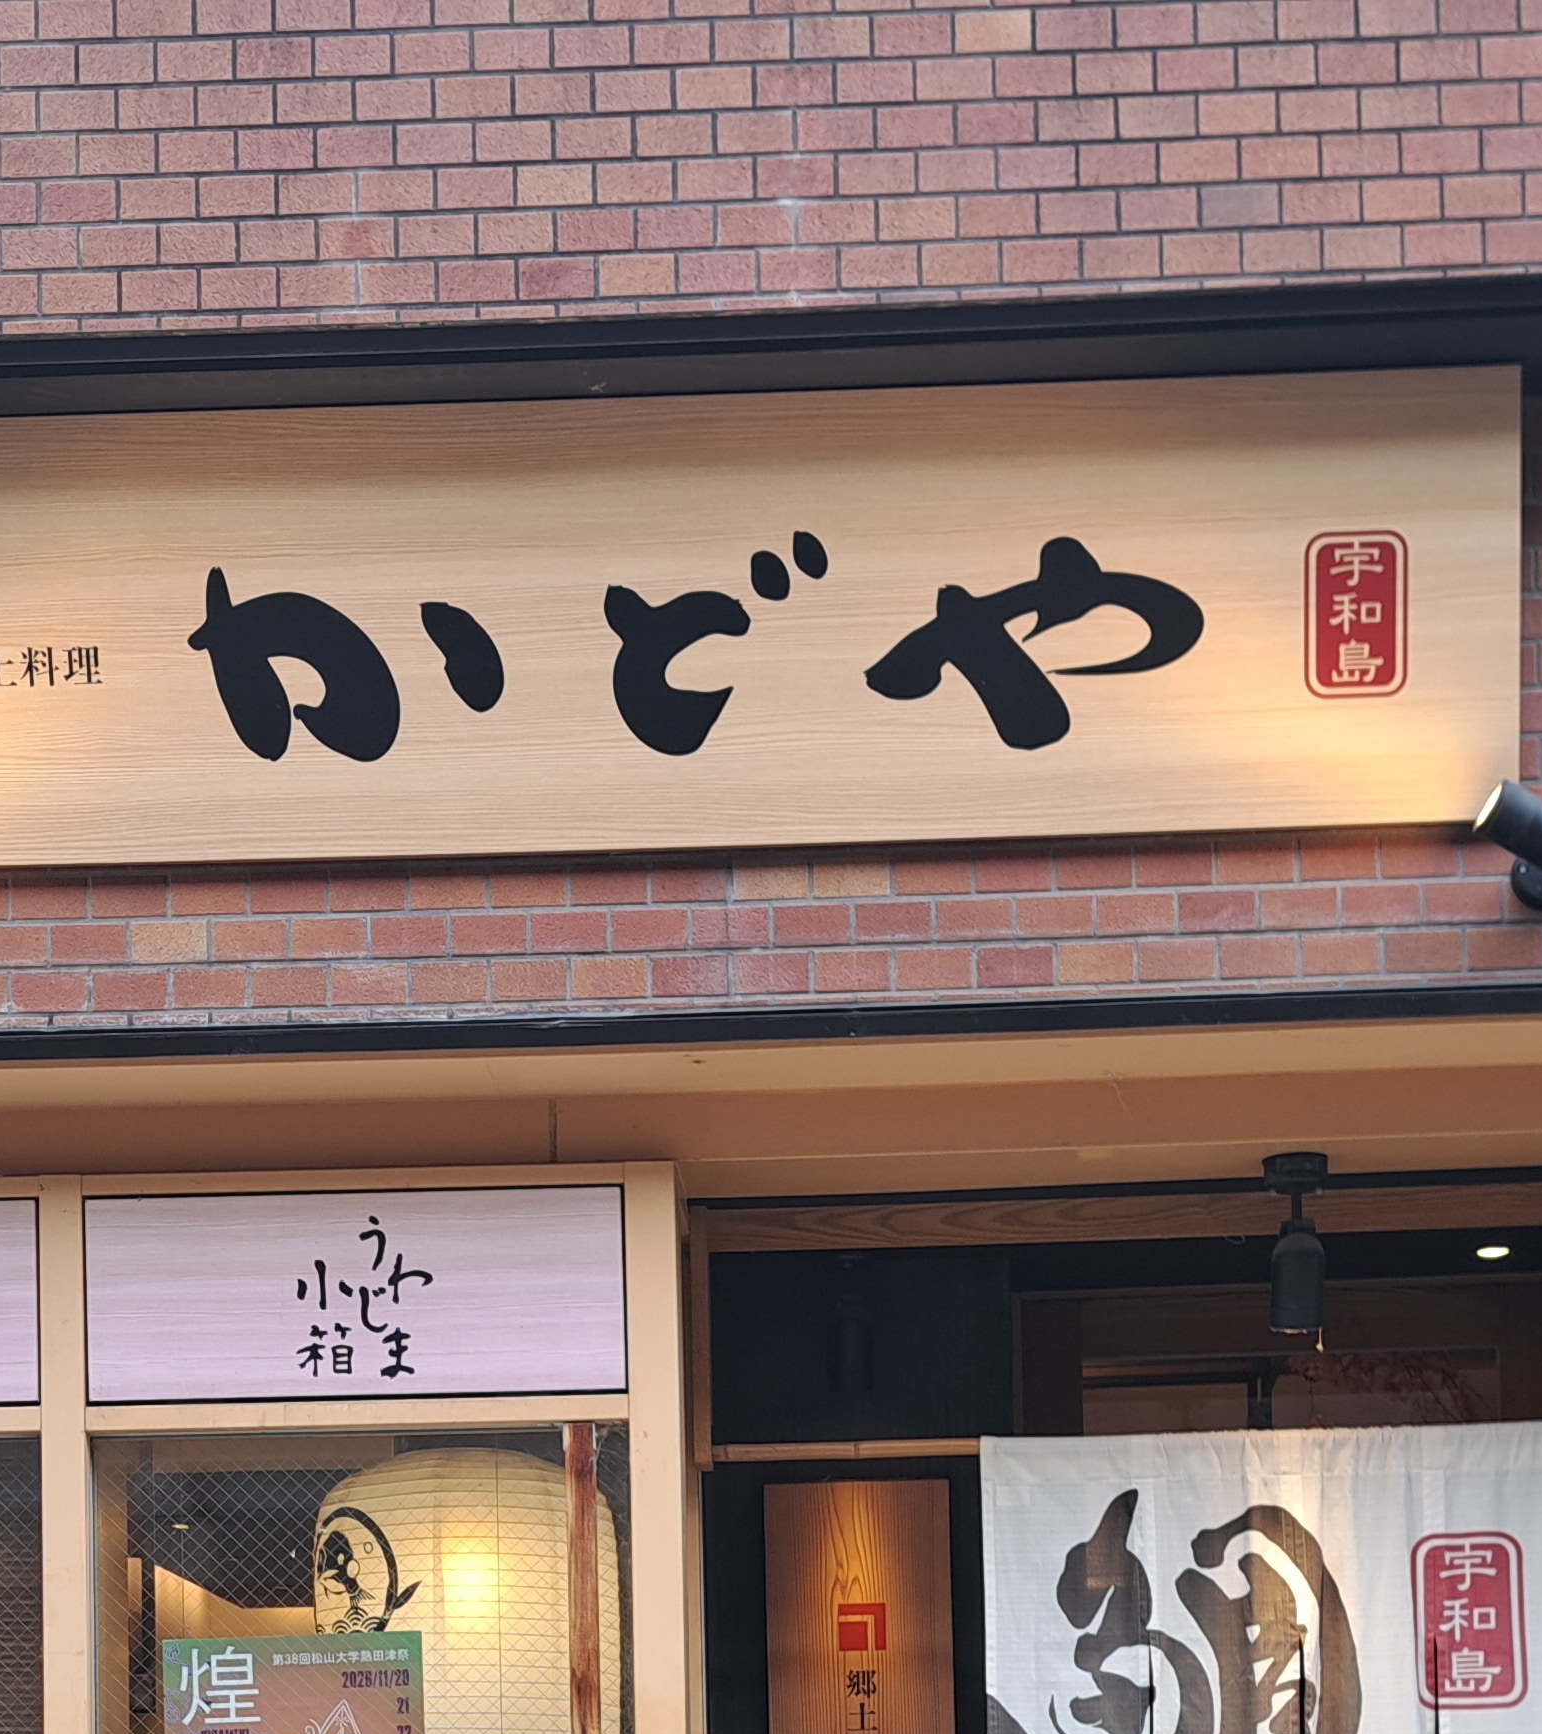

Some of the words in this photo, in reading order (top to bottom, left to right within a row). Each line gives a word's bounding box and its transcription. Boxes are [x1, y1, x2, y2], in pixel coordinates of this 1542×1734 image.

[188, 531, 1204, 763] かどや
[1328, 538, 1387, 690] 宇和島
[295, 1258, 356, 1376] 小箱
[358, 1217, 434, 1377] うわじま
[180, 1646, 261, 1726] 煌
[1439, 1542, 1502, 1694] 宇和島
[397, 1697, 410, 1715] 21
